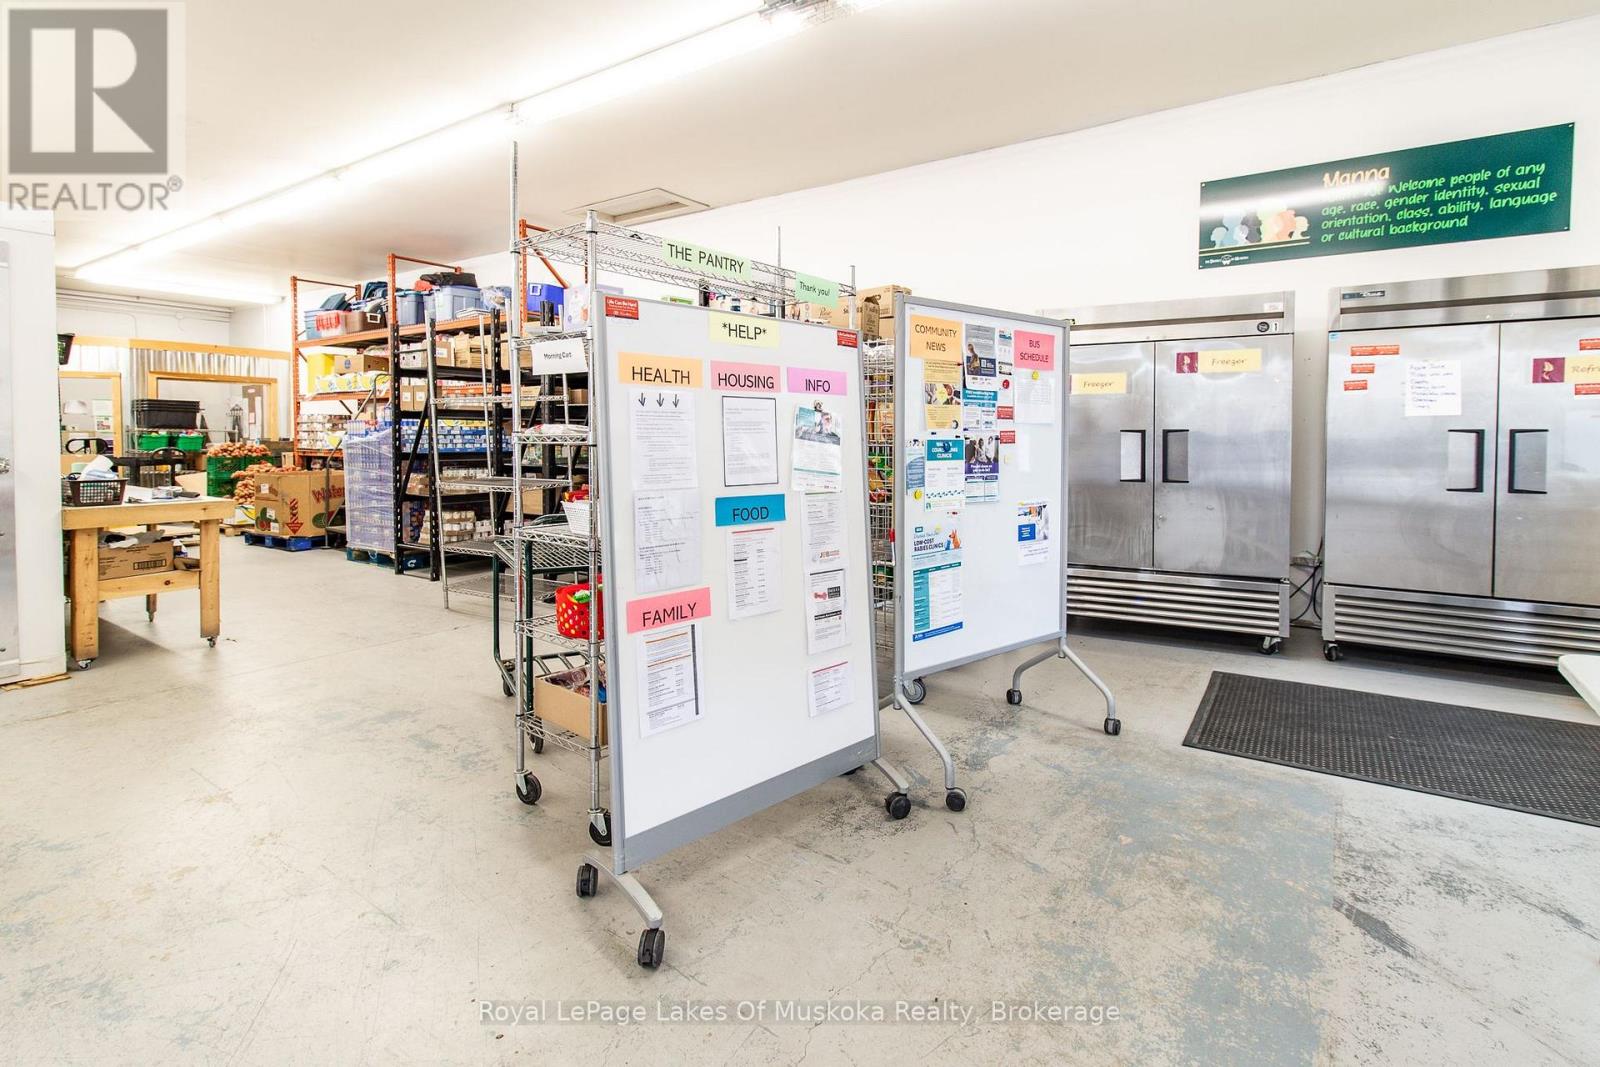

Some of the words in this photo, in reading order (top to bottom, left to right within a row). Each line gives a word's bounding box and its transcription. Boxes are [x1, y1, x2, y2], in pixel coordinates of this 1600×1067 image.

[1323, 166, 1390, 188] Manna
[1388, 178, 1446, 194] Welcome
[1450, 169, 1491, 188] people
[1496, 165, 1511, 179] of
[1515, 163, 1546, 176] any
[1384, 193, 1430, 210] gender
[1494, 176, 1541, 194] sexual
[1489, 191, 1558, 209] language
[1321, 233, 1335, 243] or
[1338, 224, 1385, 241] cultural
[1389, 215, 1469, 235] background
[667, 243, 693, 262] THE
[698, 249, 745, 274] PANTRY
[799, 281, 817, 294] Thank
[817, 286, 831, 297] you!
[914, 323, 958, 338] COMMUNITY
[925, 341, 947, 352] NEWS
[1028, 339, 1041, 349] BUS
[543, 352, 562, 360] Morning
[1019, 351, 1049, 363] SCHEDULE
[631, 366, 691, 385] HEALTH
[717, 372, 775, 390] HOUSING
[805, 378, 831, 393] INFO
[732, 506, 770, 523] FOOD
[642, 602, 698, 627] FAMILY
